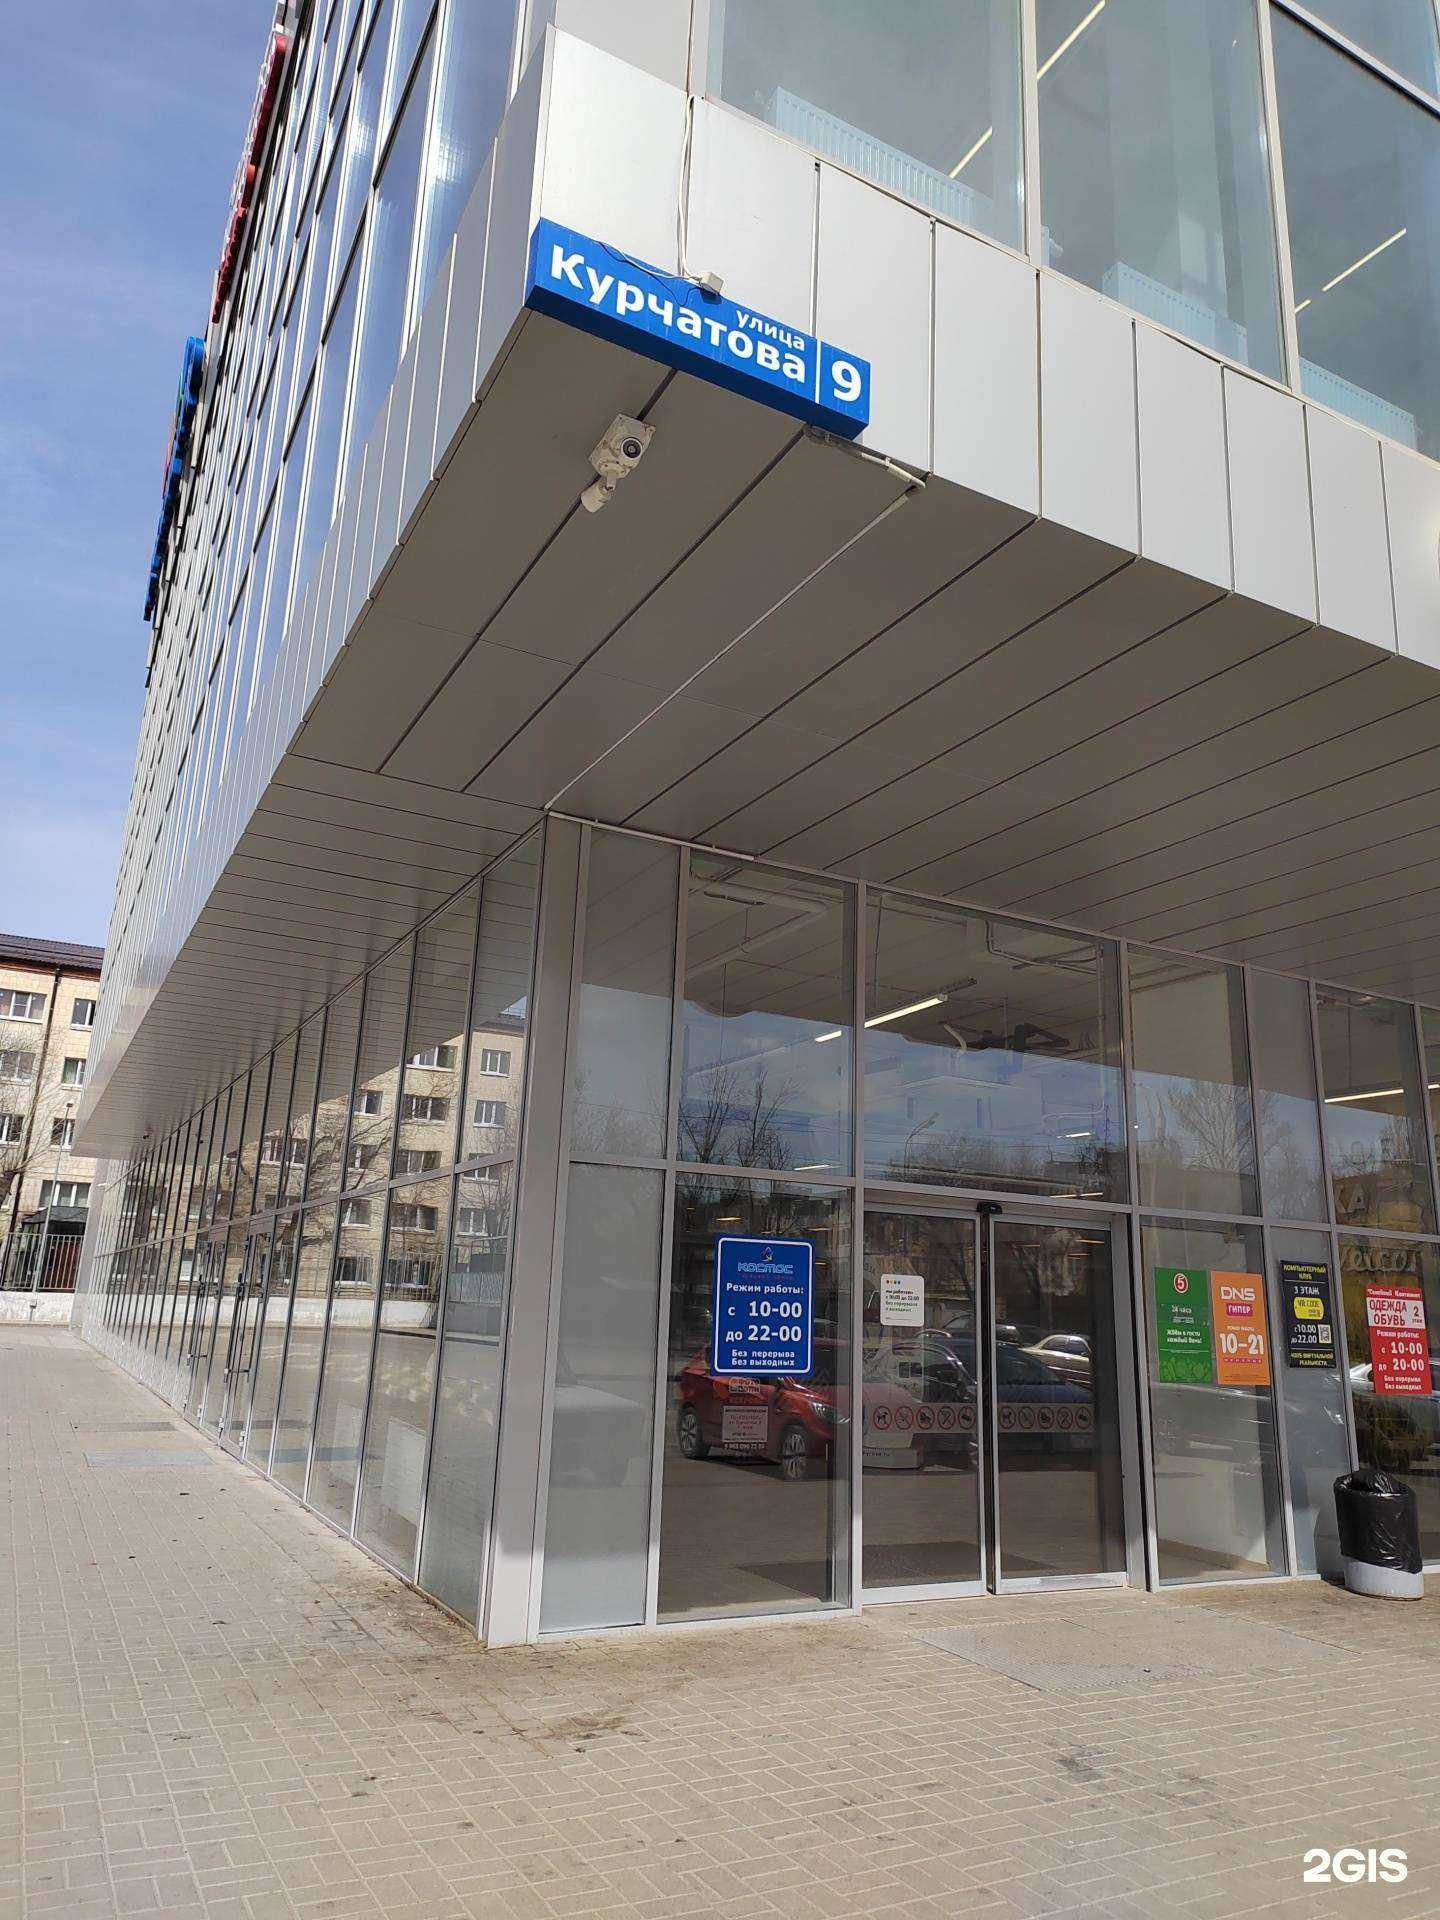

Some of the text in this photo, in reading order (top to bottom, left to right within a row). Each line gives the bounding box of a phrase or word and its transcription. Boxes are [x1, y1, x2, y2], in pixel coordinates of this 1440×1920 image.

[550, 244, 806, 383] Курчатова
[736, 308, 805, 351] улица
[831, 361, 862, 402] 9
[1283, 1264, 1326, 1273] КОМПЬЮТЕРНЫЙ
[1299, 1272, 1312, 1280] КЛУБ
[726, 1283, 804, 1294] Режим работы:
[1220, 1286, 1256, 1301] DNS
[1294, 1286, 1319, 1295] 3 ЭТАЖ
[728, 1301, 802, 1318] с 10-00
[1228, 1305, 1251, 1314] ГИПЕР
[1369, 1300, 1407, 1313] ОДЕЖДА
[1414, 1307, 1419, 1316] 2
[1374, 1314, 1406, 1326] ОБУВЬ
[726, 1325, 802, 1342] до 22-00
[1298, 1335, 1317, 1344] 22.00
[1397, 1331, 1419, 1340] работы:
[732, 1349, 747, 1357] Без
[1391, 1342, 1423, 1354] 10-00
[1378, 1359, 1424, 1372] до 20-00
